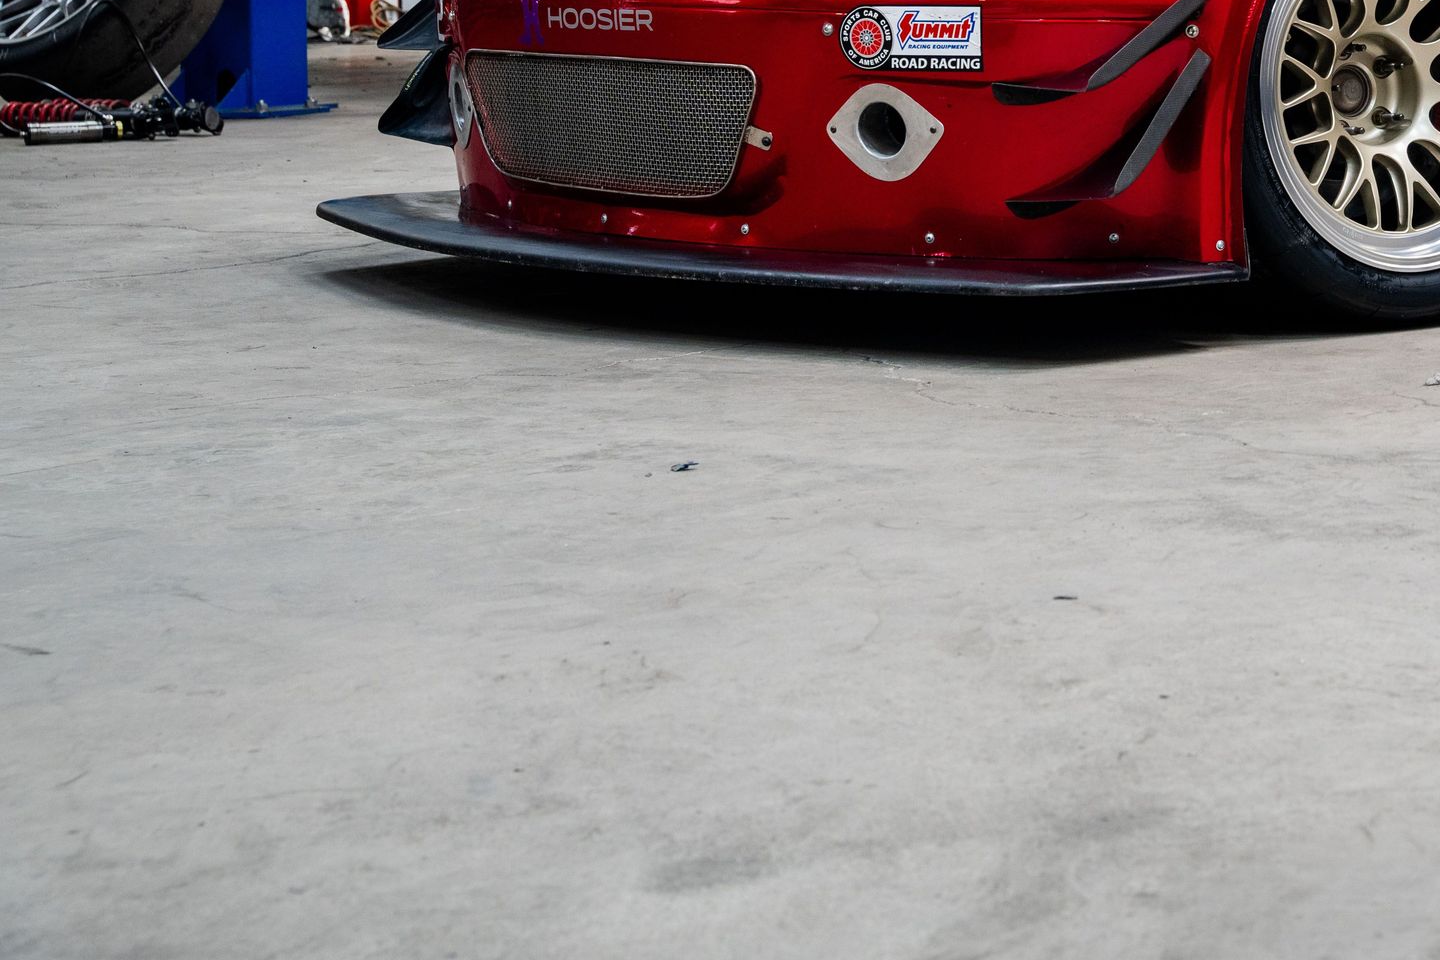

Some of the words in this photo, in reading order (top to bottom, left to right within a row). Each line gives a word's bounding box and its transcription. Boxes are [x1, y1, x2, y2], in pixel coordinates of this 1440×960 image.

[547, 7, 654, 32] HOOSIER
[843, 11, 861, 42] SPORTS
[863, 9, 879, 19] CAR
[880, 19, 891, 41] CLUB
[848, 49, 858, 59] OF
[858, 48, 889, 66] AMERICA
[891, 58, 928, 69] ROAD
[930, 58, 981, 70] RACING
